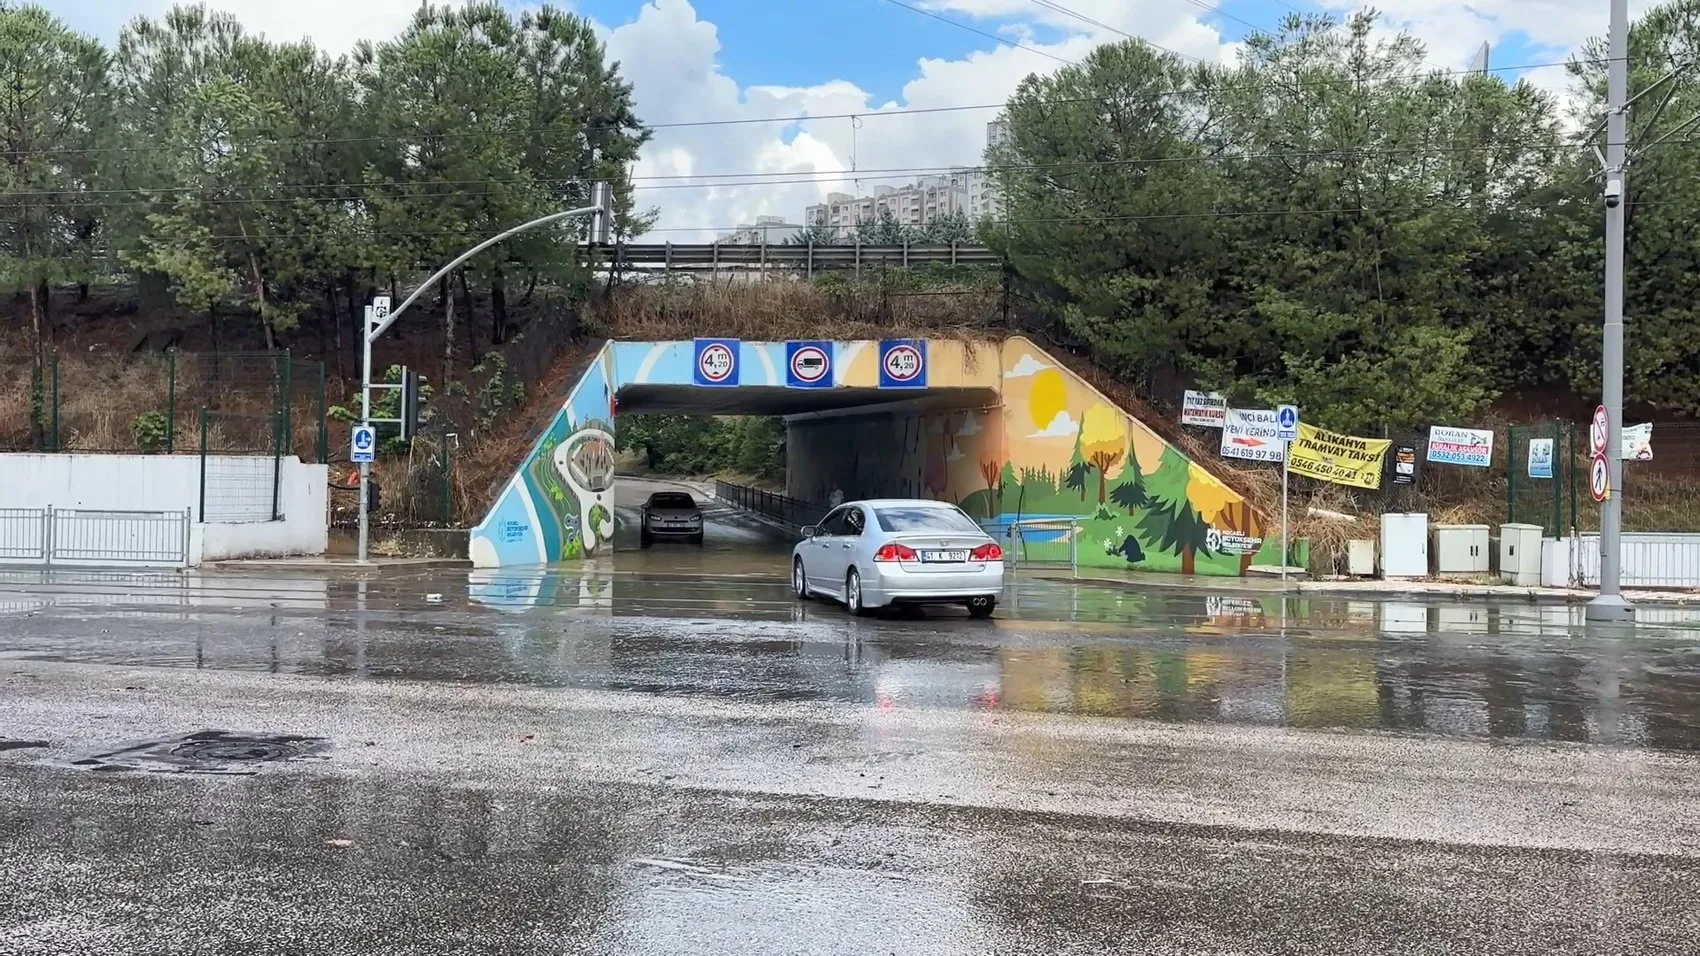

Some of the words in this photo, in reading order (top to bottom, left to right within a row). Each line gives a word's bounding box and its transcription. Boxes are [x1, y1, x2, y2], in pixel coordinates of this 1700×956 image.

[1246, 426, 1276, 437] YERİND
[1240, 448, 1254, 457] 619
[1255, 450, 1267, 459] 97
[1269, 451, 1282, 460] 98
[1299, 439, 1348, 457] TRAMVAY
[1291, 457, 1313, 470] 0546
[1314, 463, 1333, 474] 450
[1345, 470, 1358, 479] 41
